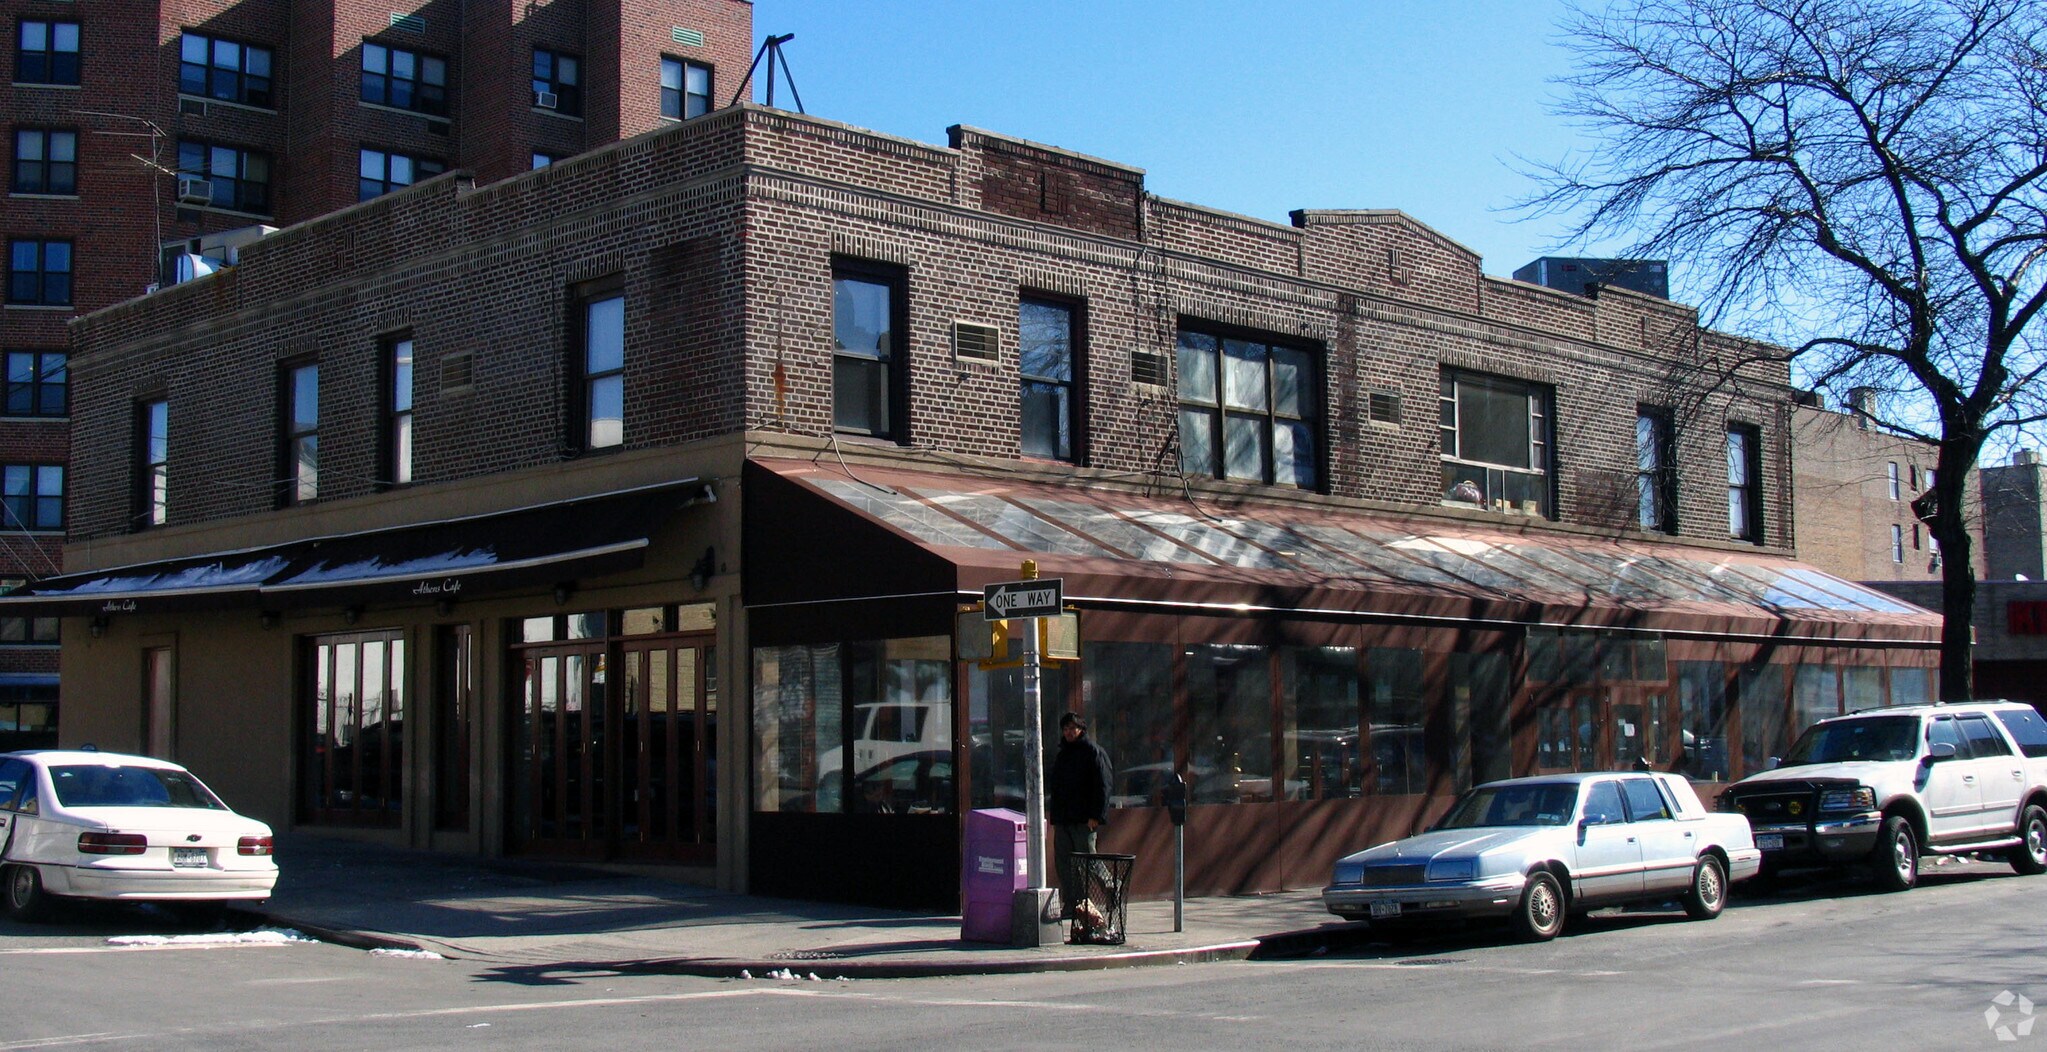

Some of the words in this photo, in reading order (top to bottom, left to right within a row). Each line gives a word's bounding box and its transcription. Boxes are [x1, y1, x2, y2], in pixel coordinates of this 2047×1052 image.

[412, 581, 441, 595] Athens
[996, 594, 1017, 608] ONE
[1028, 591, 1051, 606] WAY
